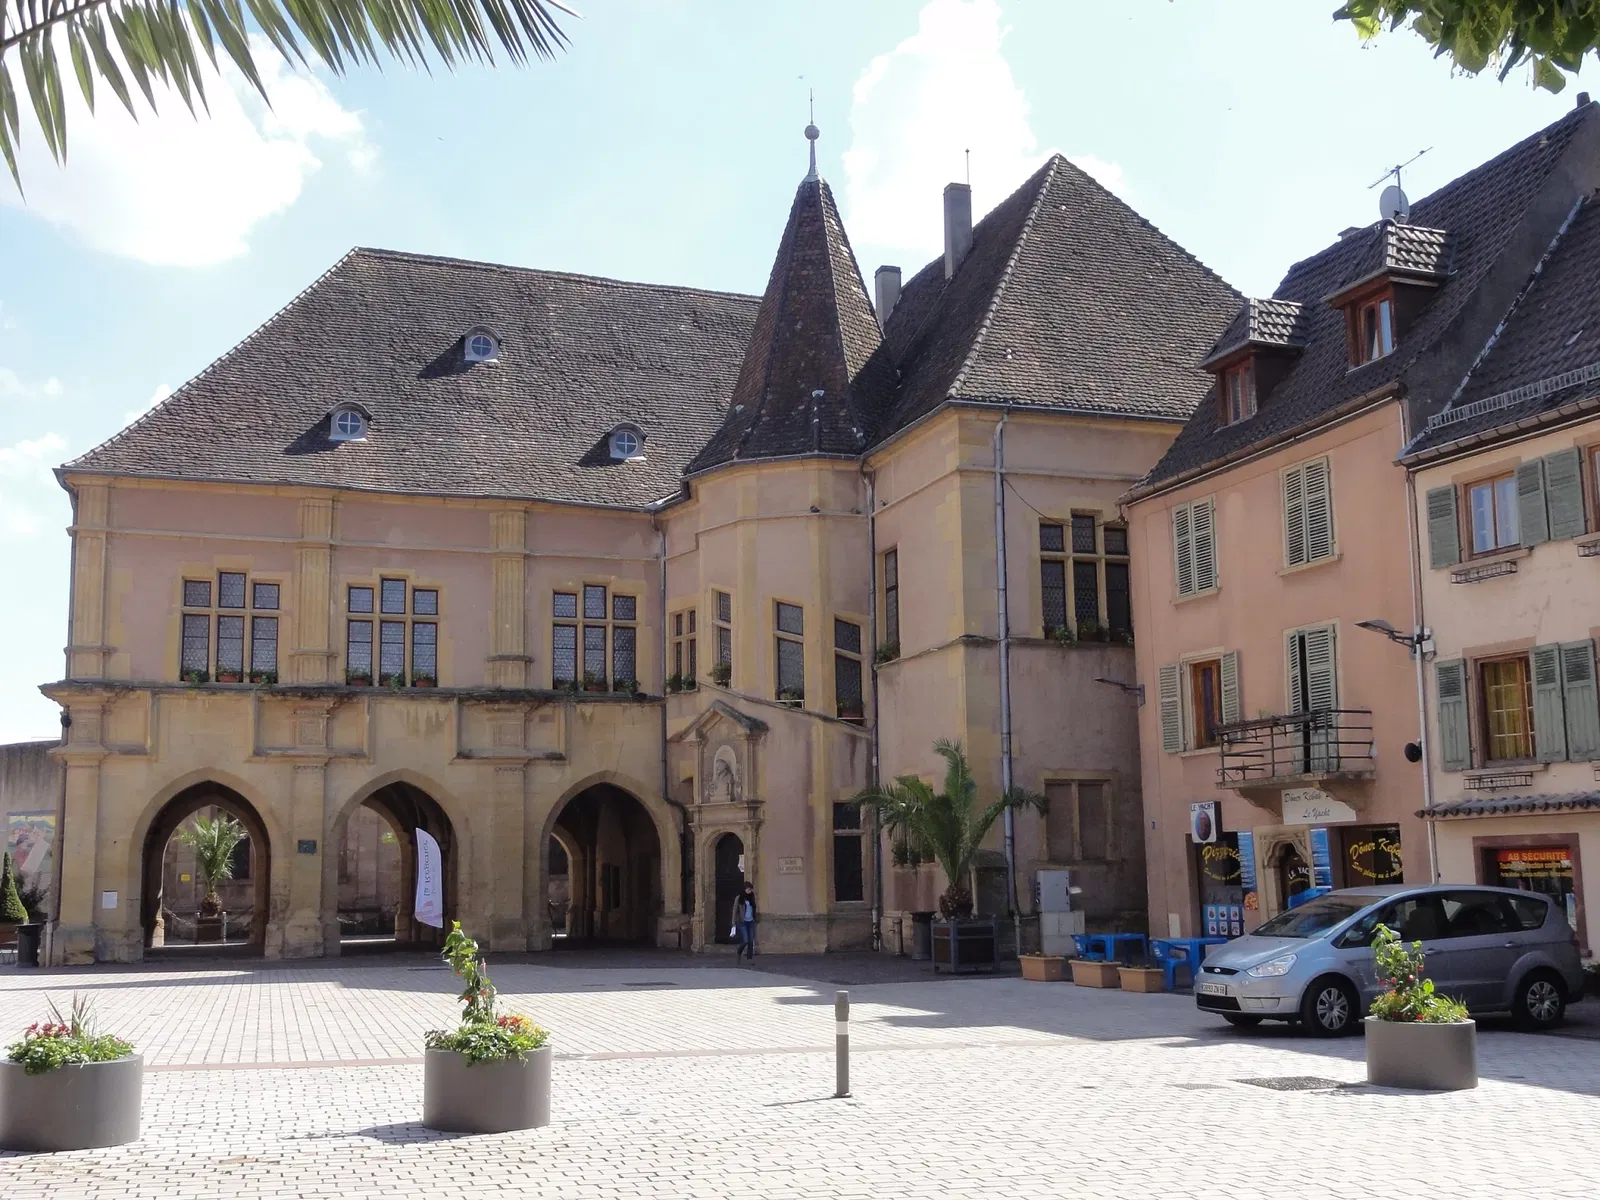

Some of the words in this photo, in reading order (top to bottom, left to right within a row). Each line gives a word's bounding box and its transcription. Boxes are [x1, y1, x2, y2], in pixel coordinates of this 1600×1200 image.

[1190, 804, 1197, 812] LE
[1198, 802, 1214, 811] YACHT
[1507, 852, 1520, 861] AB
